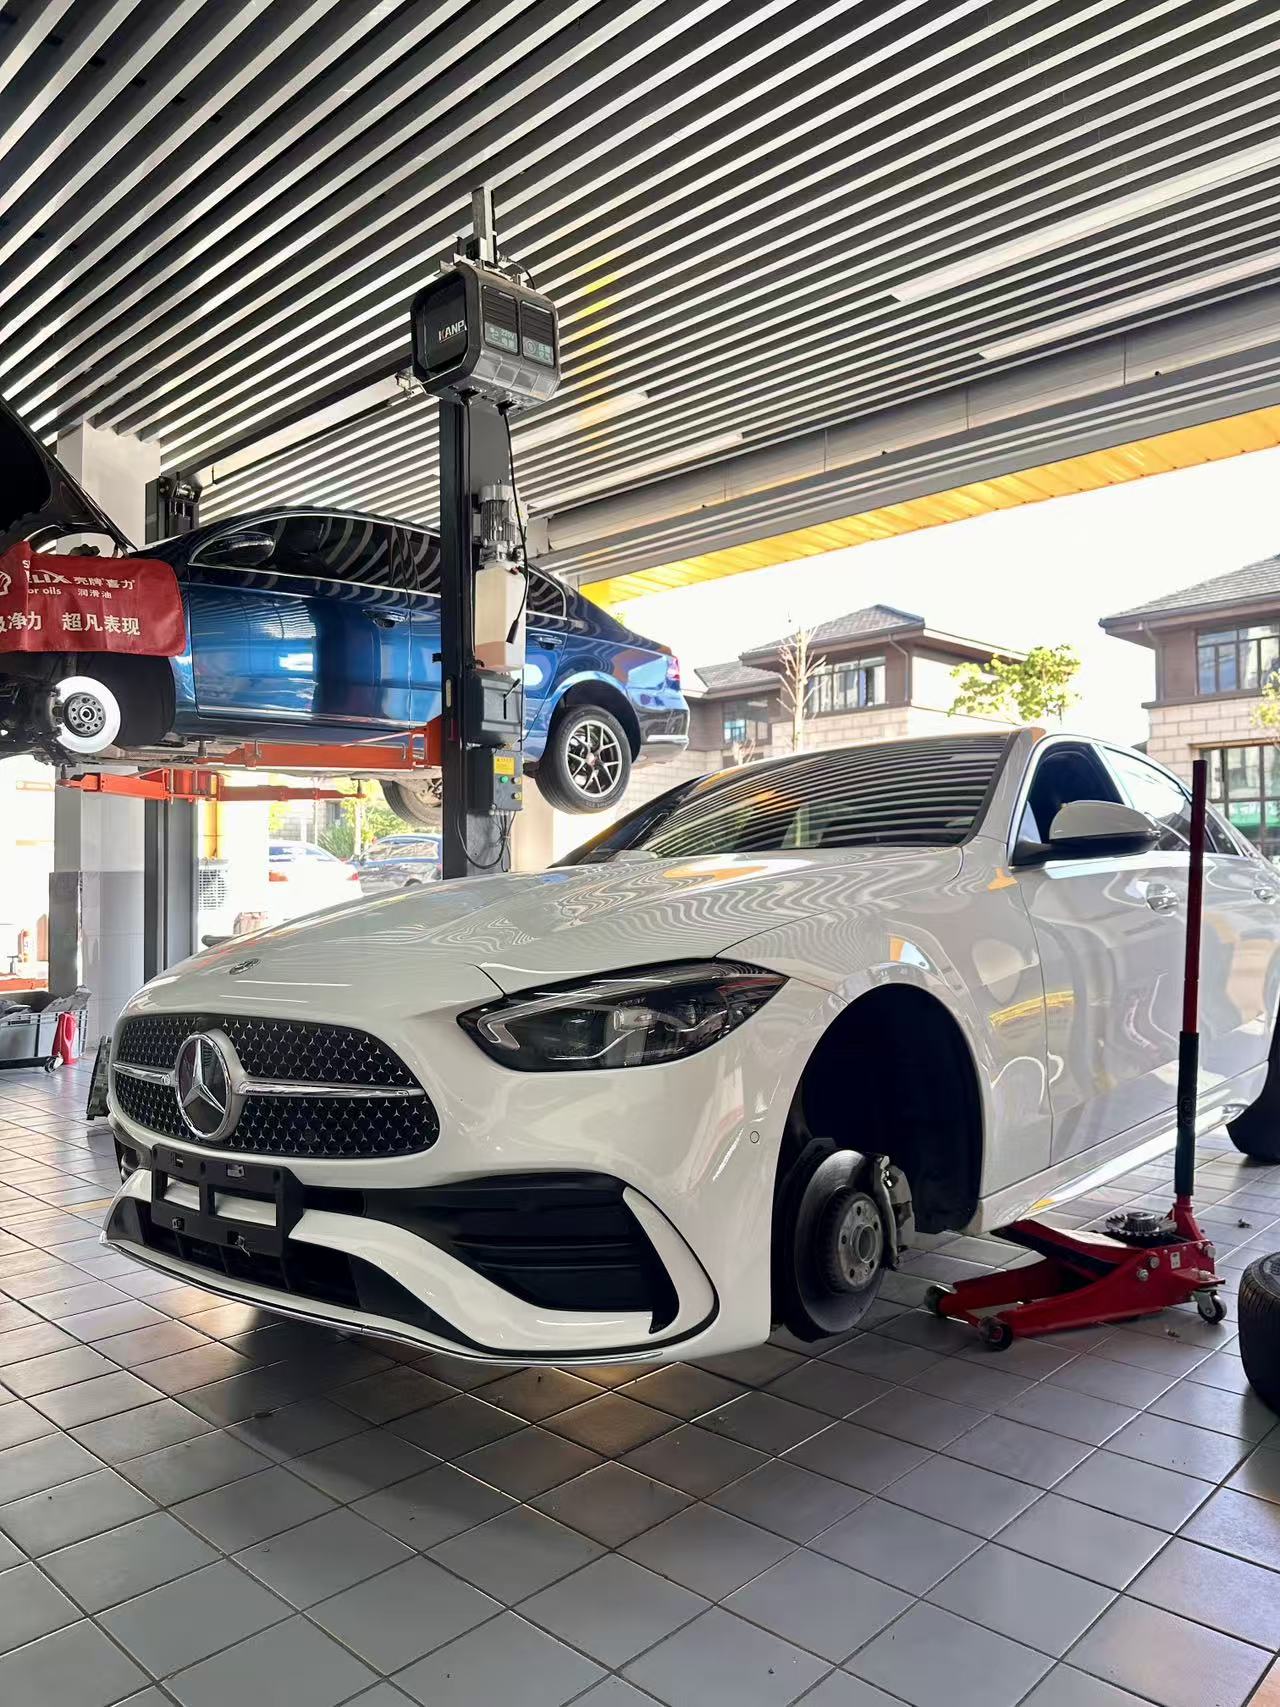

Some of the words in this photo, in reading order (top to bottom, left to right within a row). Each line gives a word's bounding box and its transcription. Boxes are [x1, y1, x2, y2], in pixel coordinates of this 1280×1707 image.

[42, 586, 62, 595] oils
[77, 588, 112, 599] 润滑油
[62, 612, 141, 636] 超凡表现
